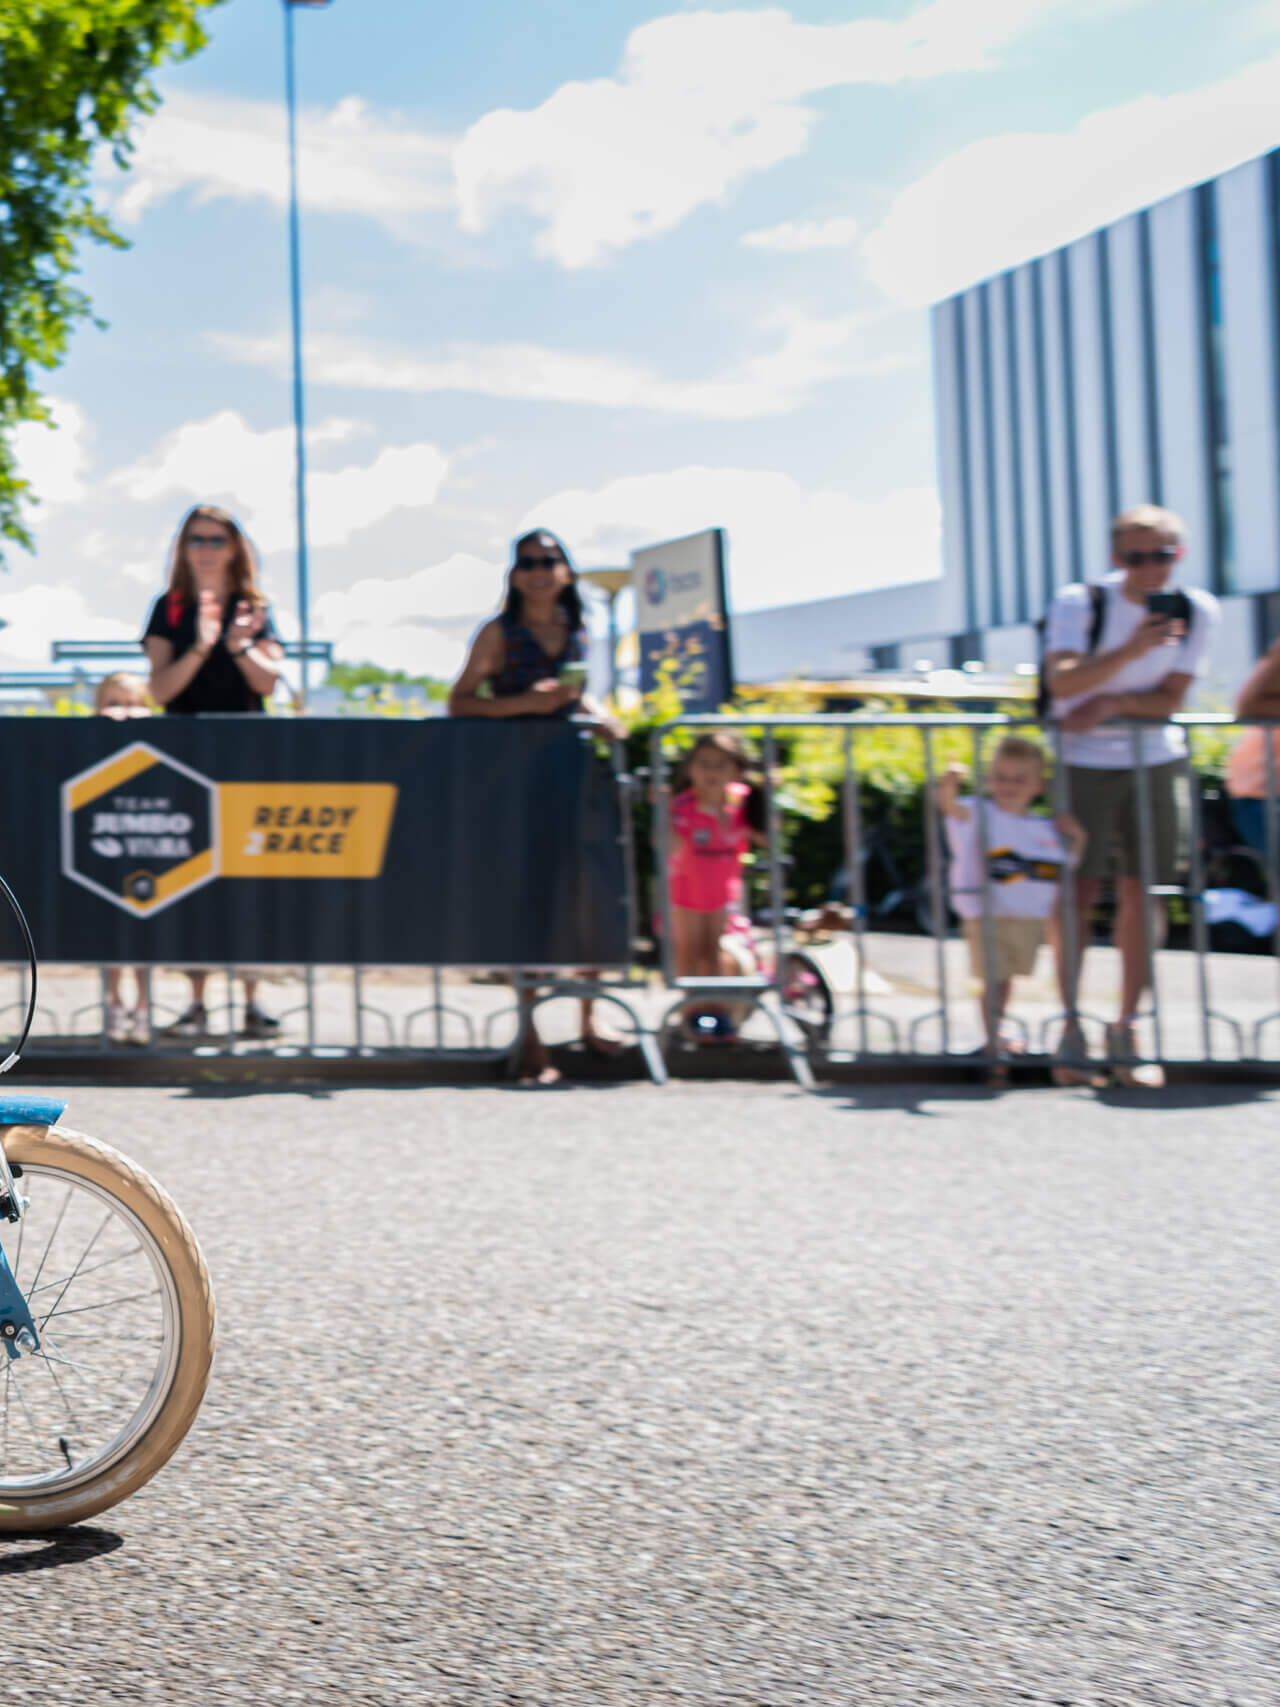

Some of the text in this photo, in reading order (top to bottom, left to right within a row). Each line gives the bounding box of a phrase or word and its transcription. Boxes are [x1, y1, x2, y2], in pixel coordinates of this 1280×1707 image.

[114, 797, 170, 809] TEAM
[91, 813, 193, 834] JUMBO
[253, 805, 359, 828] READY
